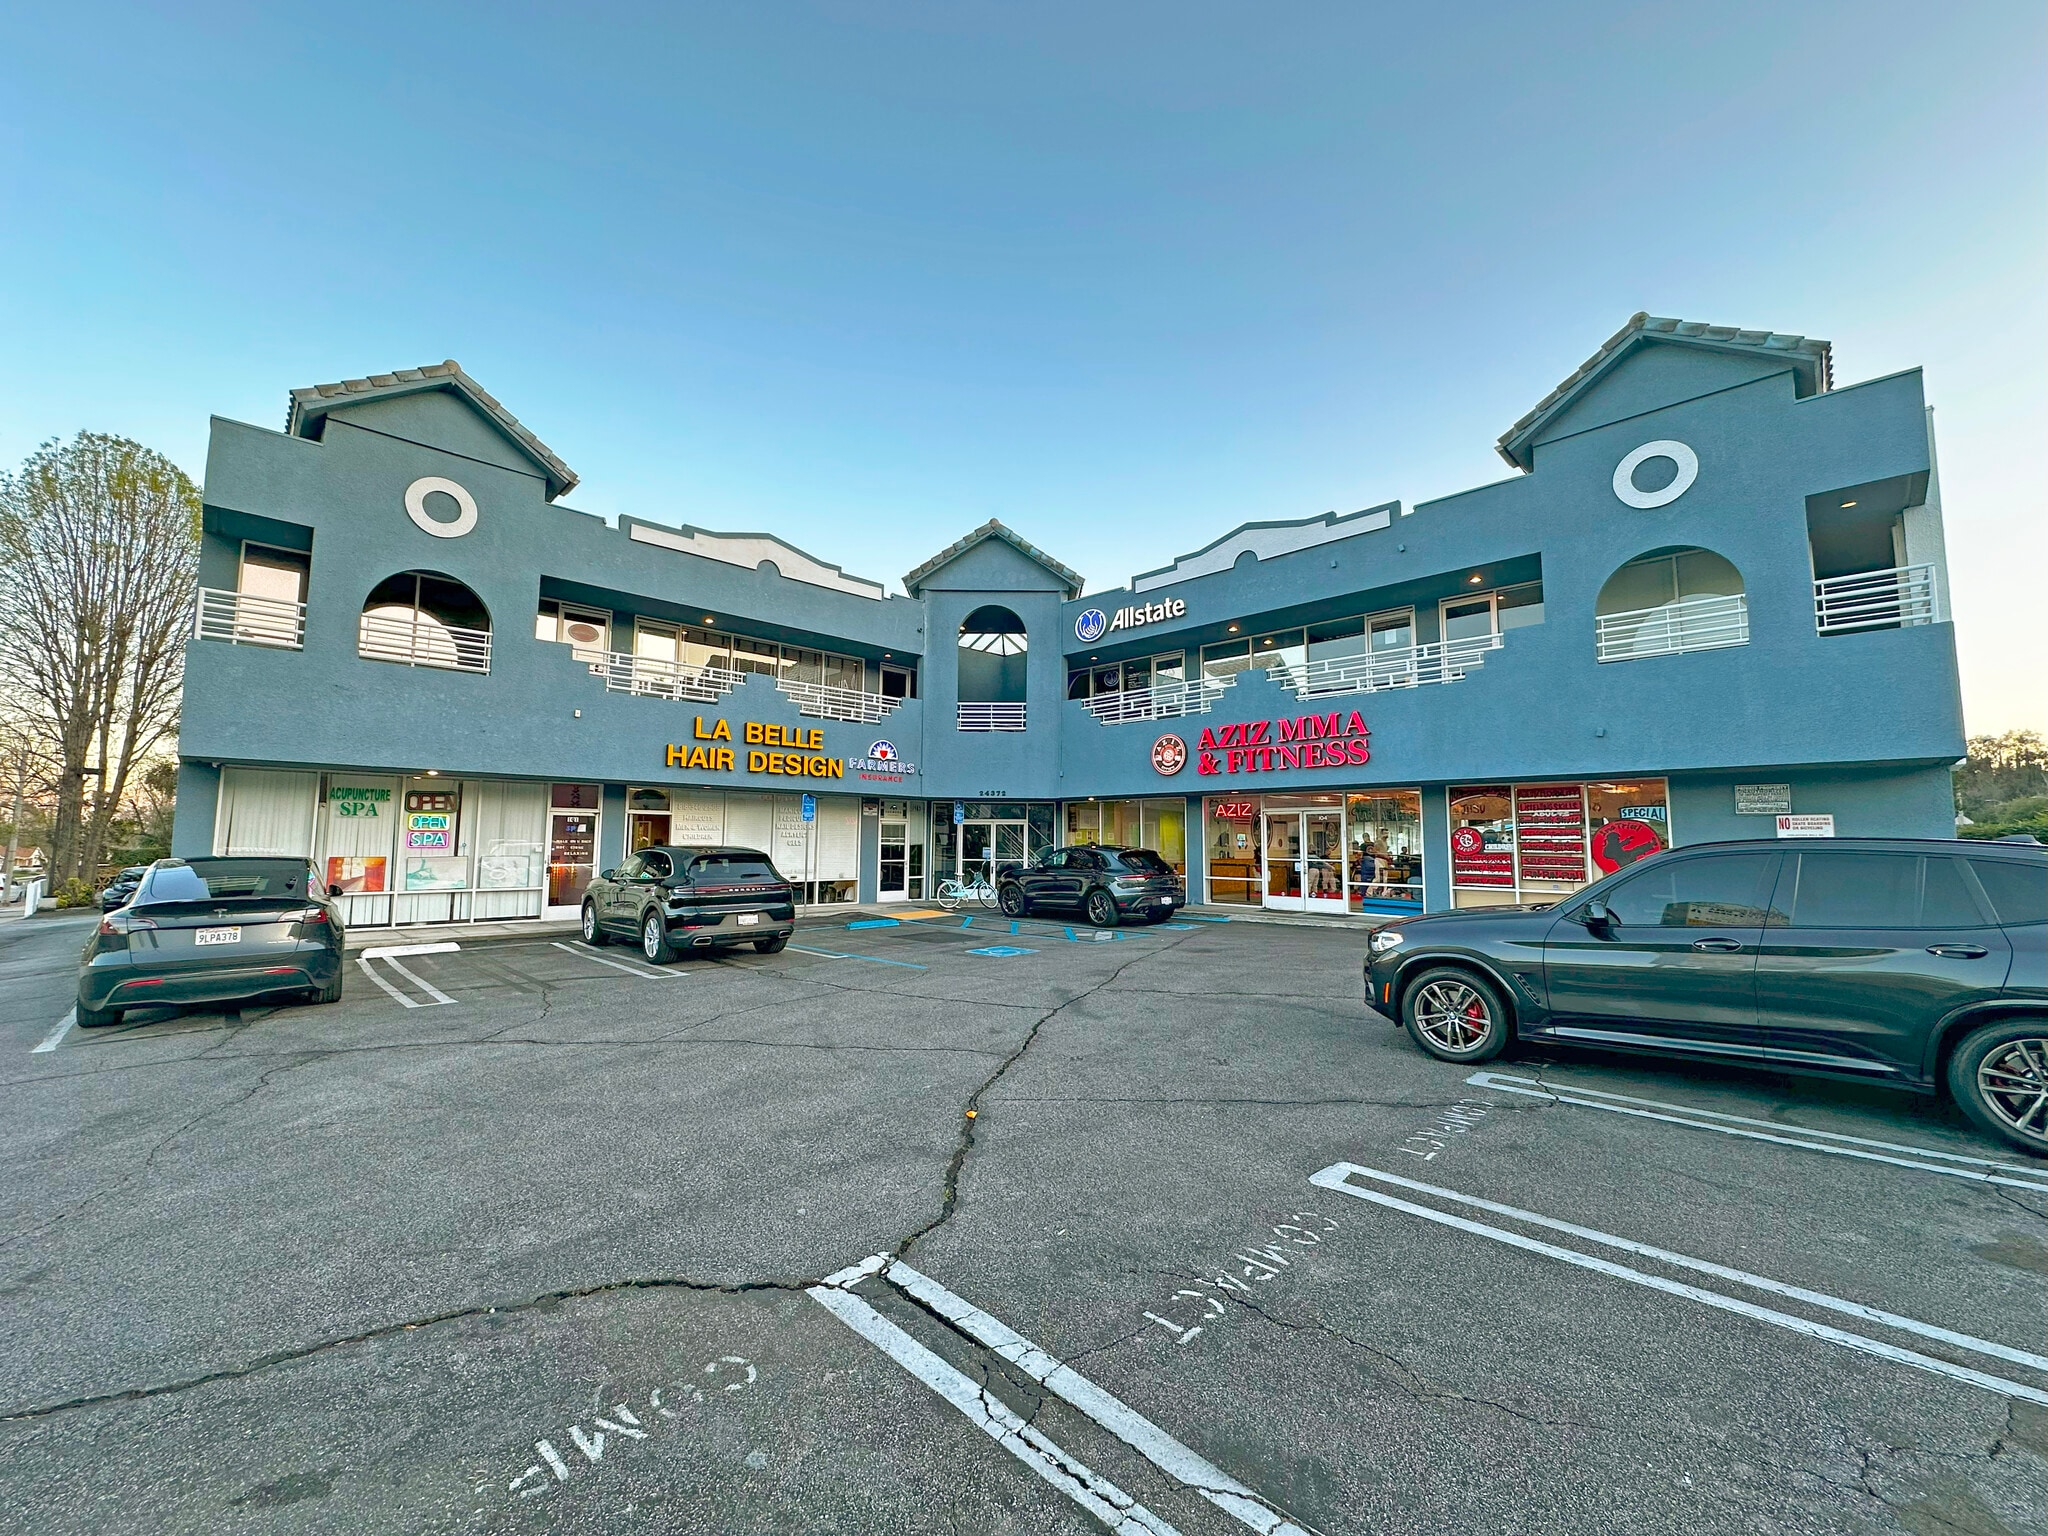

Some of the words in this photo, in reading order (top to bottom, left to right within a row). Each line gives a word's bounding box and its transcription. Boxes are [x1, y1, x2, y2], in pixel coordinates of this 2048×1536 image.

[1109, 597, 1185, 632] Allstate
[694, 716, 732, 741] LA
[744, 722, 824, 750] BELLE
[1197, 720, 1271, 750] AZIZ
[1277, 710, 1371, 743] MMA
[666, 744, 735, 771] HAIR
[747, 751, 843, 778] DESIGN
[848, 757, 915, 774] FARMERS
[1197, 751, 1220, 776] &
[1226, 739, 1370, 773] FITNESS
[858, 773, 903, 783] INSURANCE
[330, 786, 391, 801] ACUPUNCTURE
[340, 801, 378, 817] SPA
[408, 794, 458, 811] OPEN
[1215, 803, 1252, 817] AZIZ
[412, 816, 447, 829] OPEN
[1621, 808, 1665, 821] SPECIAL
[1778, 817, 1790, 830] NO
[411, 832, 446, 846] SPA
[199, 932, 238, 943] 9LPA378
[1397, 1098, 1494, 1160] COMPACT
[1142, 1212, 1340, 1344] COMPACT
